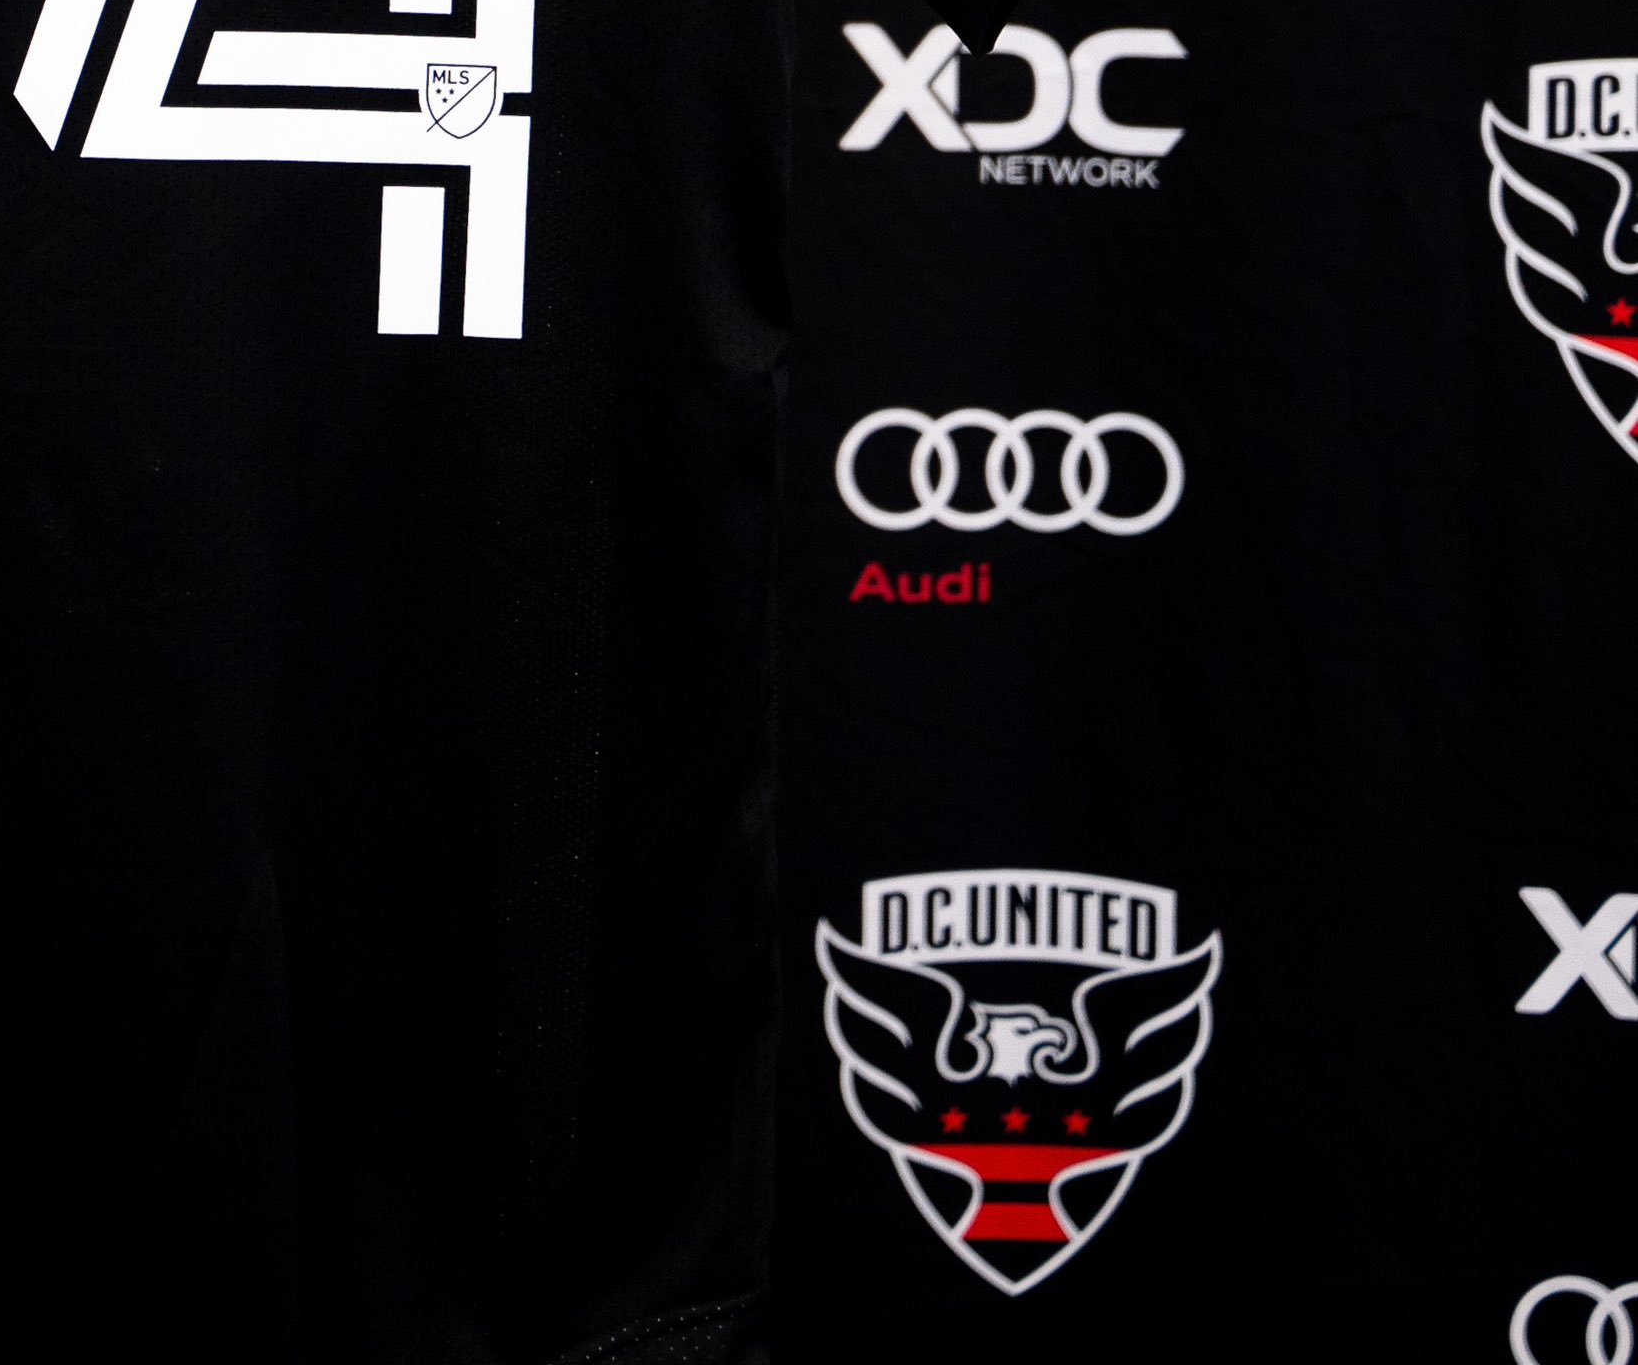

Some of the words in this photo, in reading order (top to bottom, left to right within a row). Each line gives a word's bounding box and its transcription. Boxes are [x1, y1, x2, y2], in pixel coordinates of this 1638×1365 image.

[433, 70, 469, 85] MLS
[838, 22, 1189, 157] XDC
[979, 156, 1160, 189] NETWORK
[849, 562, 992, 604] Audi
